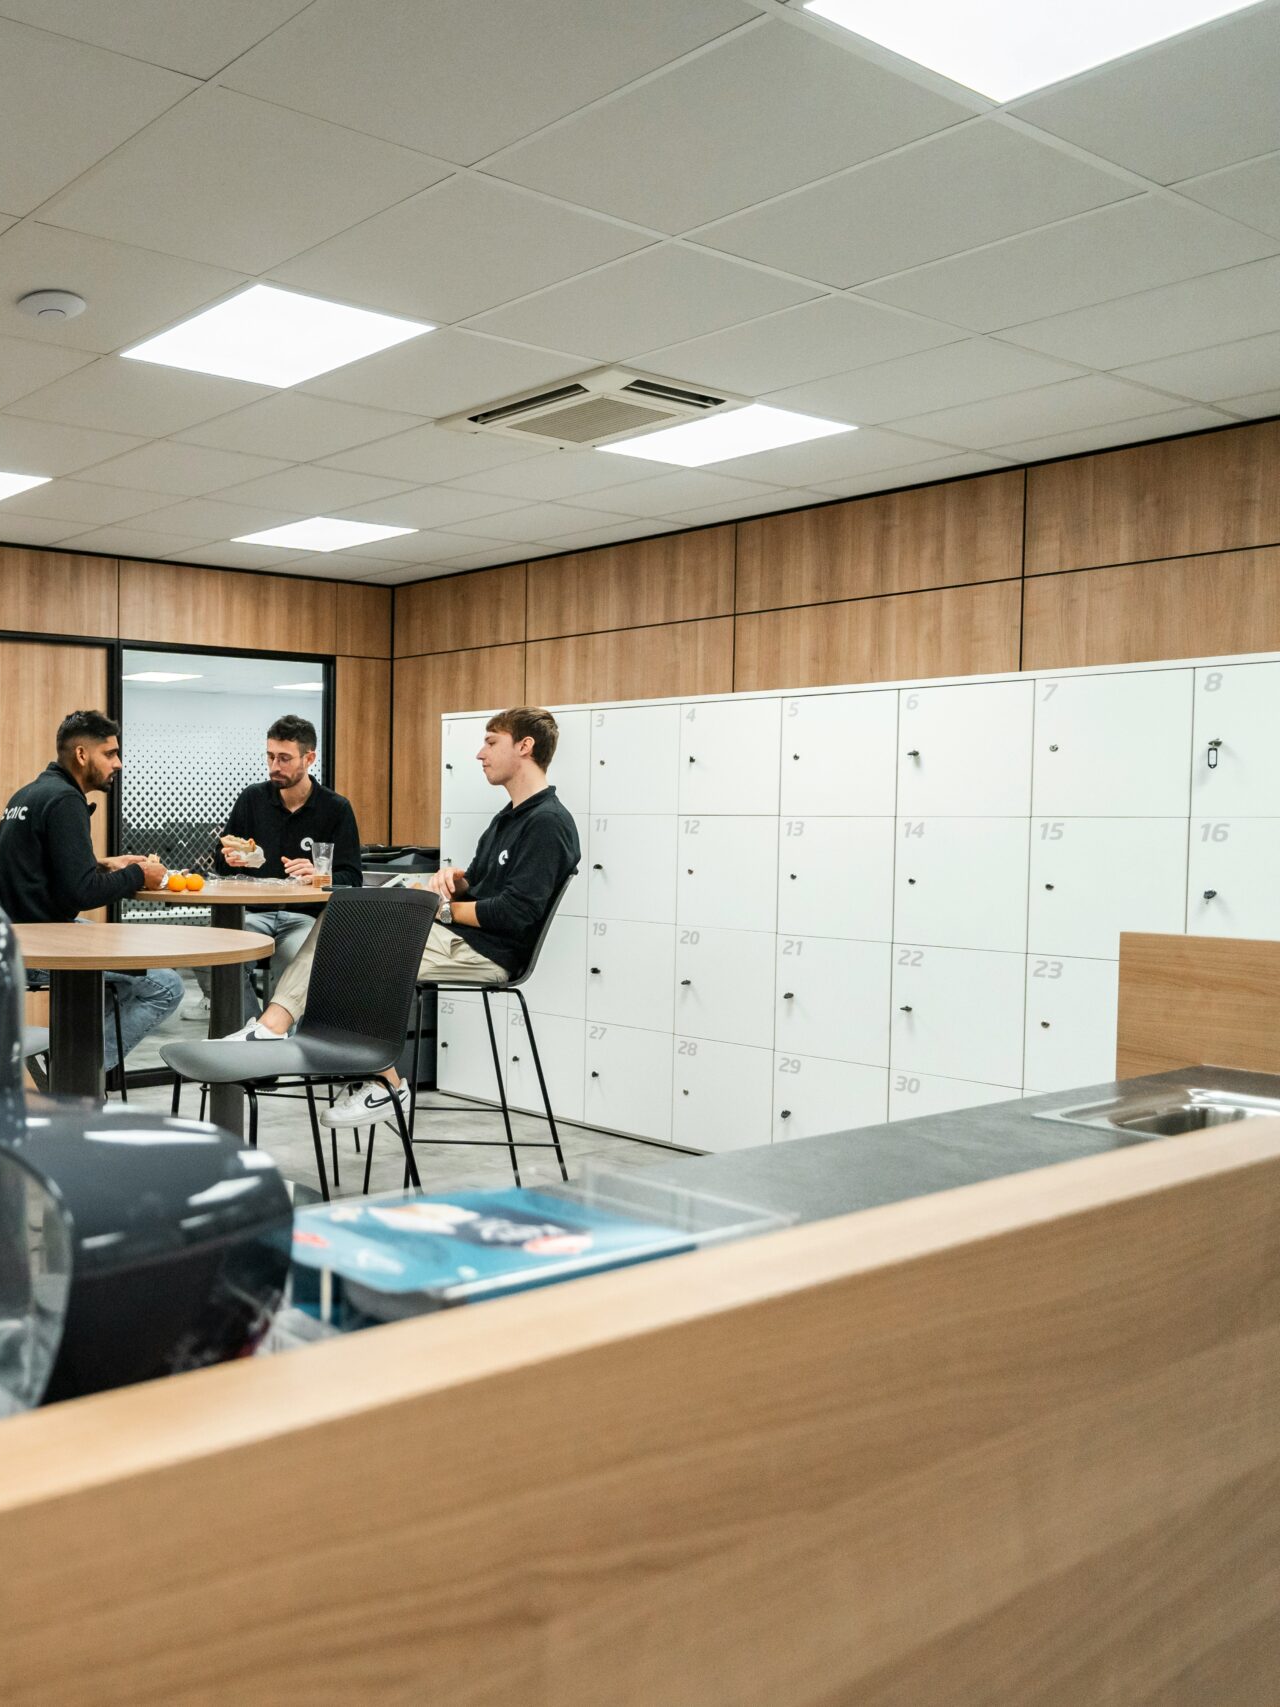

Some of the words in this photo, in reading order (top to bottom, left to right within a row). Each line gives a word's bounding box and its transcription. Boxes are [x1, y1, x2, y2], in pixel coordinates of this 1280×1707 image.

[1204, 672, 1223, 692] 8
[1043, 683, 1058, 701] 7
[788, 702, 799, 717] 5
[906, 693, 919, 710] 6
[595, 713, 605, 728] 3
[686, 708, 697, 722] 4
[444, 817, 452, 829] 9
[595, 818, 607, 832] 11
[683, 819, 700, 834] 12
[786, 821, 804, 836] 13
[904, 822, 925, 838] 14
[1040, 822, 1064, 840] 15
[1200, 823, 1230, 842] 16
[592, 922, 607, 936] 19
[680, 930, 700, 945] 20
[782, 940, 804, 956] 21
[898, 950, 924, 967] 22
[1033, 960, 1064, 979] 23
[441, 1002, 455, 1014] 25
[589, 1026, 607, 1040] 27
[677, 1040, 698, 1056] 28
[779, 1057, 801, 1074] 29
[894, 1075, 920, 1094] 30
